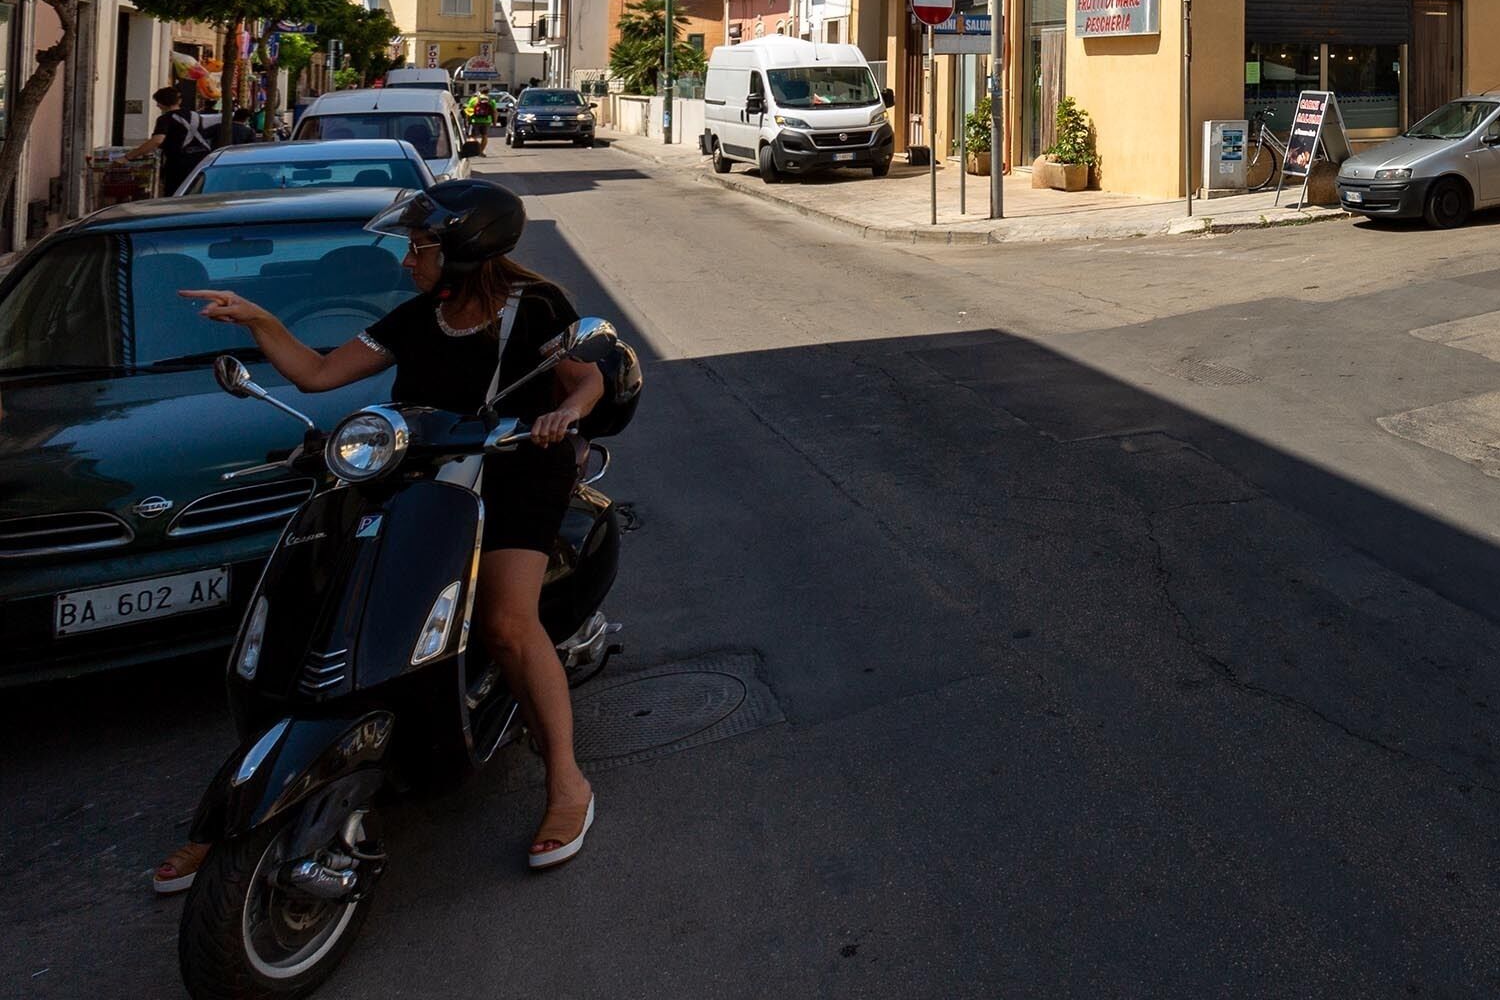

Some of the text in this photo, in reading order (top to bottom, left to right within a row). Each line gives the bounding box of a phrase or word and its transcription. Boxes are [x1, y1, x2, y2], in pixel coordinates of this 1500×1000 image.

[1085, 13, 1131, 33] PESCHERIA
[428, 44, 438, 69] FOTO
[60, 576, 223, 627] BA 602 AK
